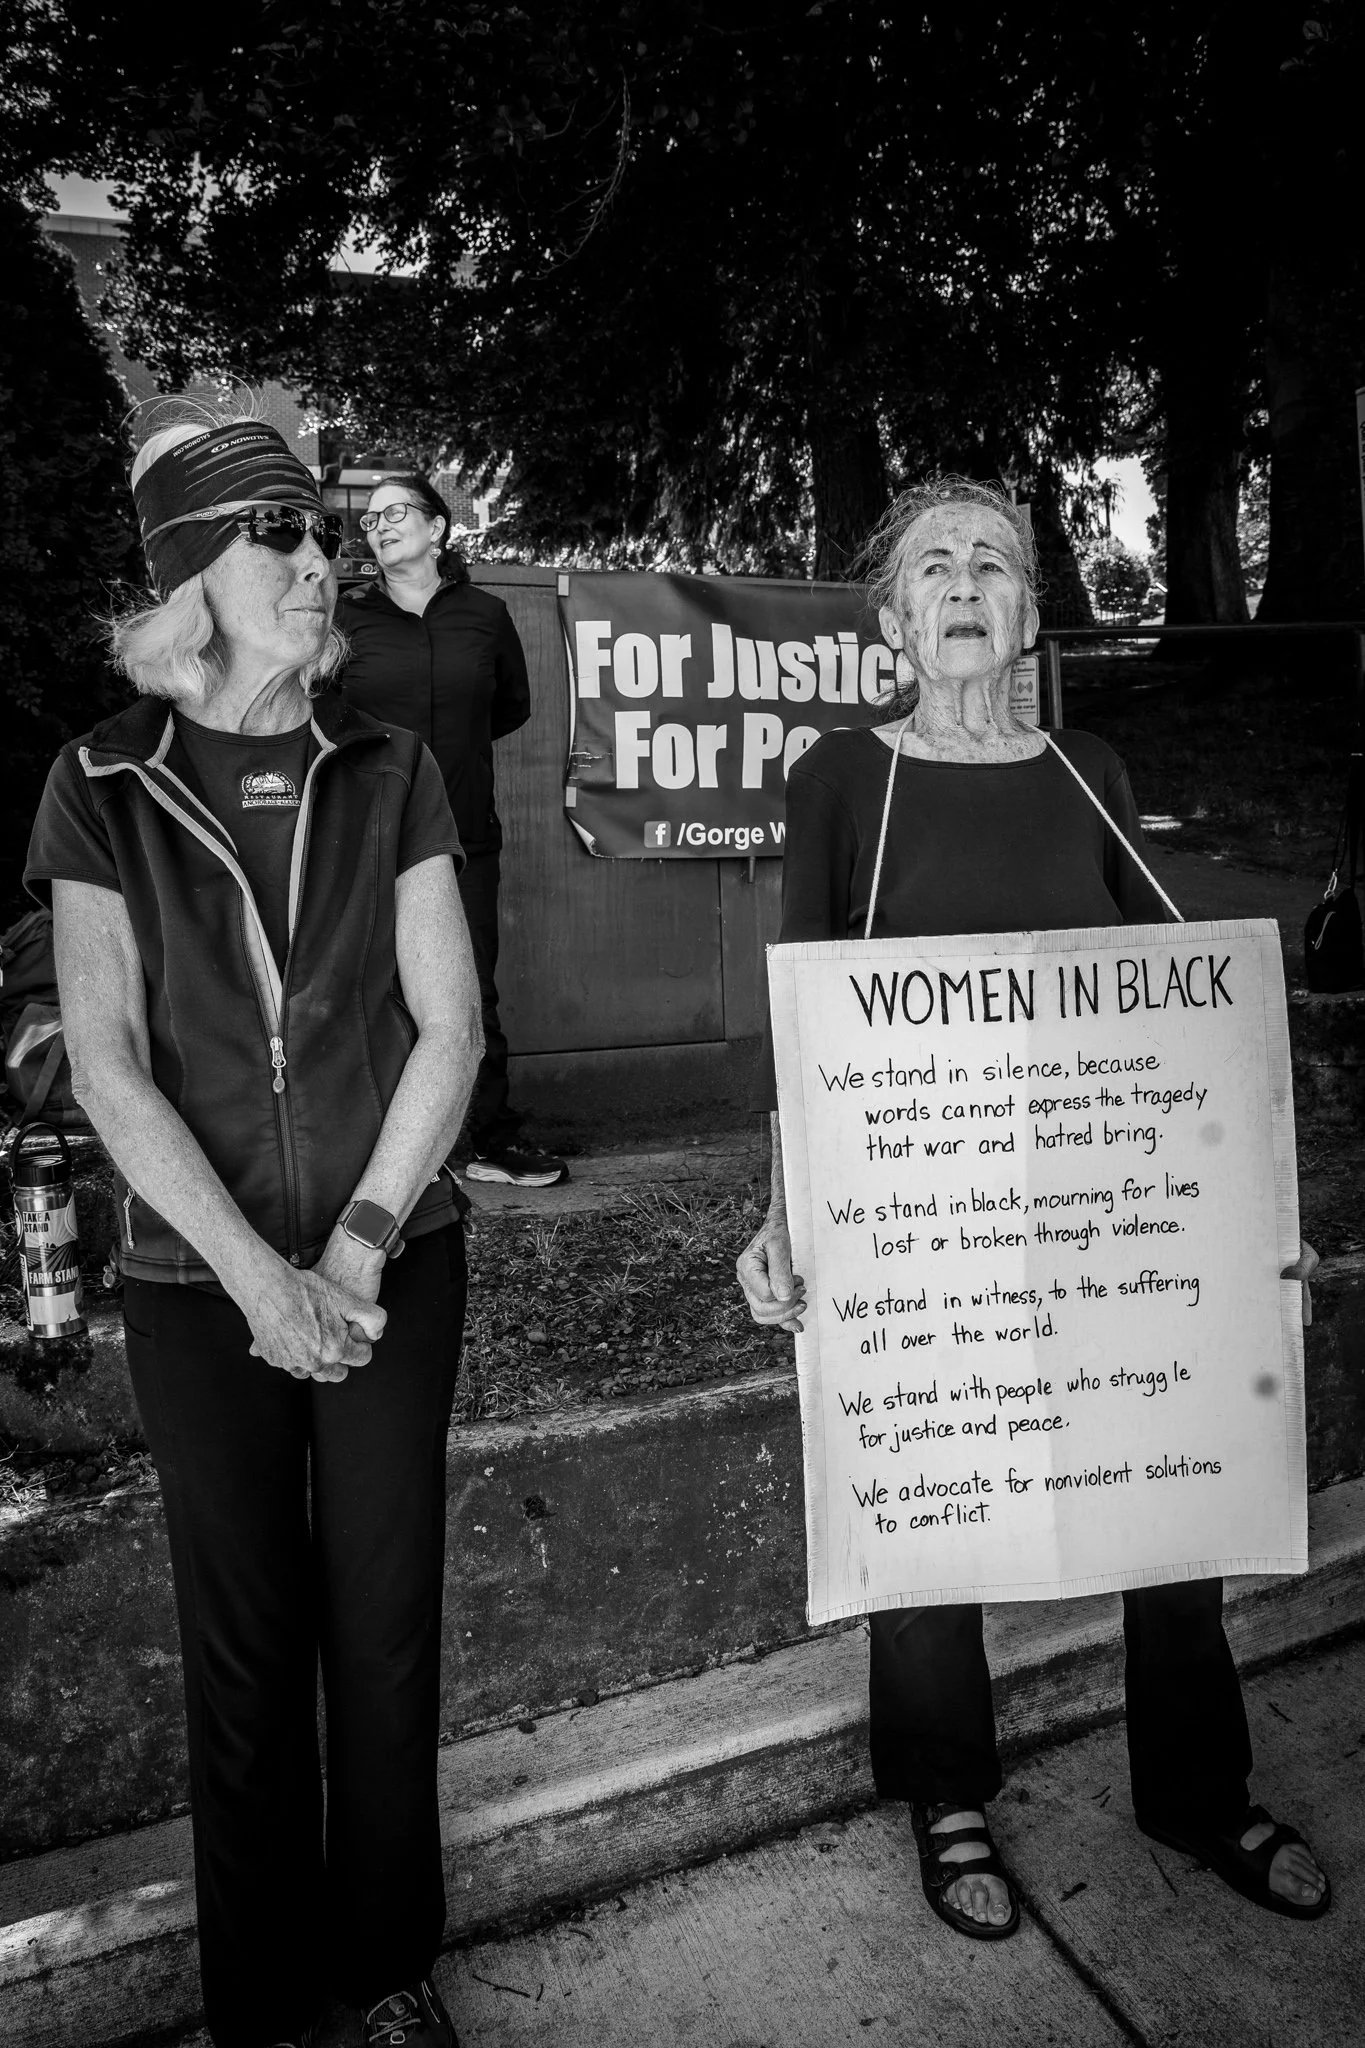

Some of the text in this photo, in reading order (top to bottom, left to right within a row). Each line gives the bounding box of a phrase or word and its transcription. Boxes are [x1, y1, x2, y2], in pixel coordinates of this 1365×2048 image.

[172, 432, 211, 457] SALOMON.COM
[230, 435, 269, 446] SALOMON
[575, 620, 692, 698] For
[615, 711, 727, 789] For
[676, 822, 764, 850] /Gorge
[849, 955, 1233, 1027] WOMEN IN BLACK
[818, 1051, 1160, 1091] We stand in silence, because
[865, 1082, 1207, 1125] words cannot express the tragedy
[866, 1120, 1163, 1161] that war and hatred bring.
[24, 1211, 51, 1222] TAKE A
[827, 1172, 1199, 1224] We stand in black, mourning for lives
[24, 1222, 49, 1233] STAND
[873, 1214, 1184, 1258] lost or broken through violence.
[28, 1272, 53, 1285] FARM
[832, 1270, 1199, 1322] We stand in witness, to the suffering
[861, 1313, 1058, 1354] all over the world.
[839, 1361, 1191, 1416] We stand with people who struggle
[859, 1424, 886, 1449] for
[889, 1419, 956, 1453] justice
[962, 1414, 996, 1436] and
[852, 1454, 1221, 1507] We advocate for nonviolent solutions
[875, 1502, 990, 1534] to conflict.
